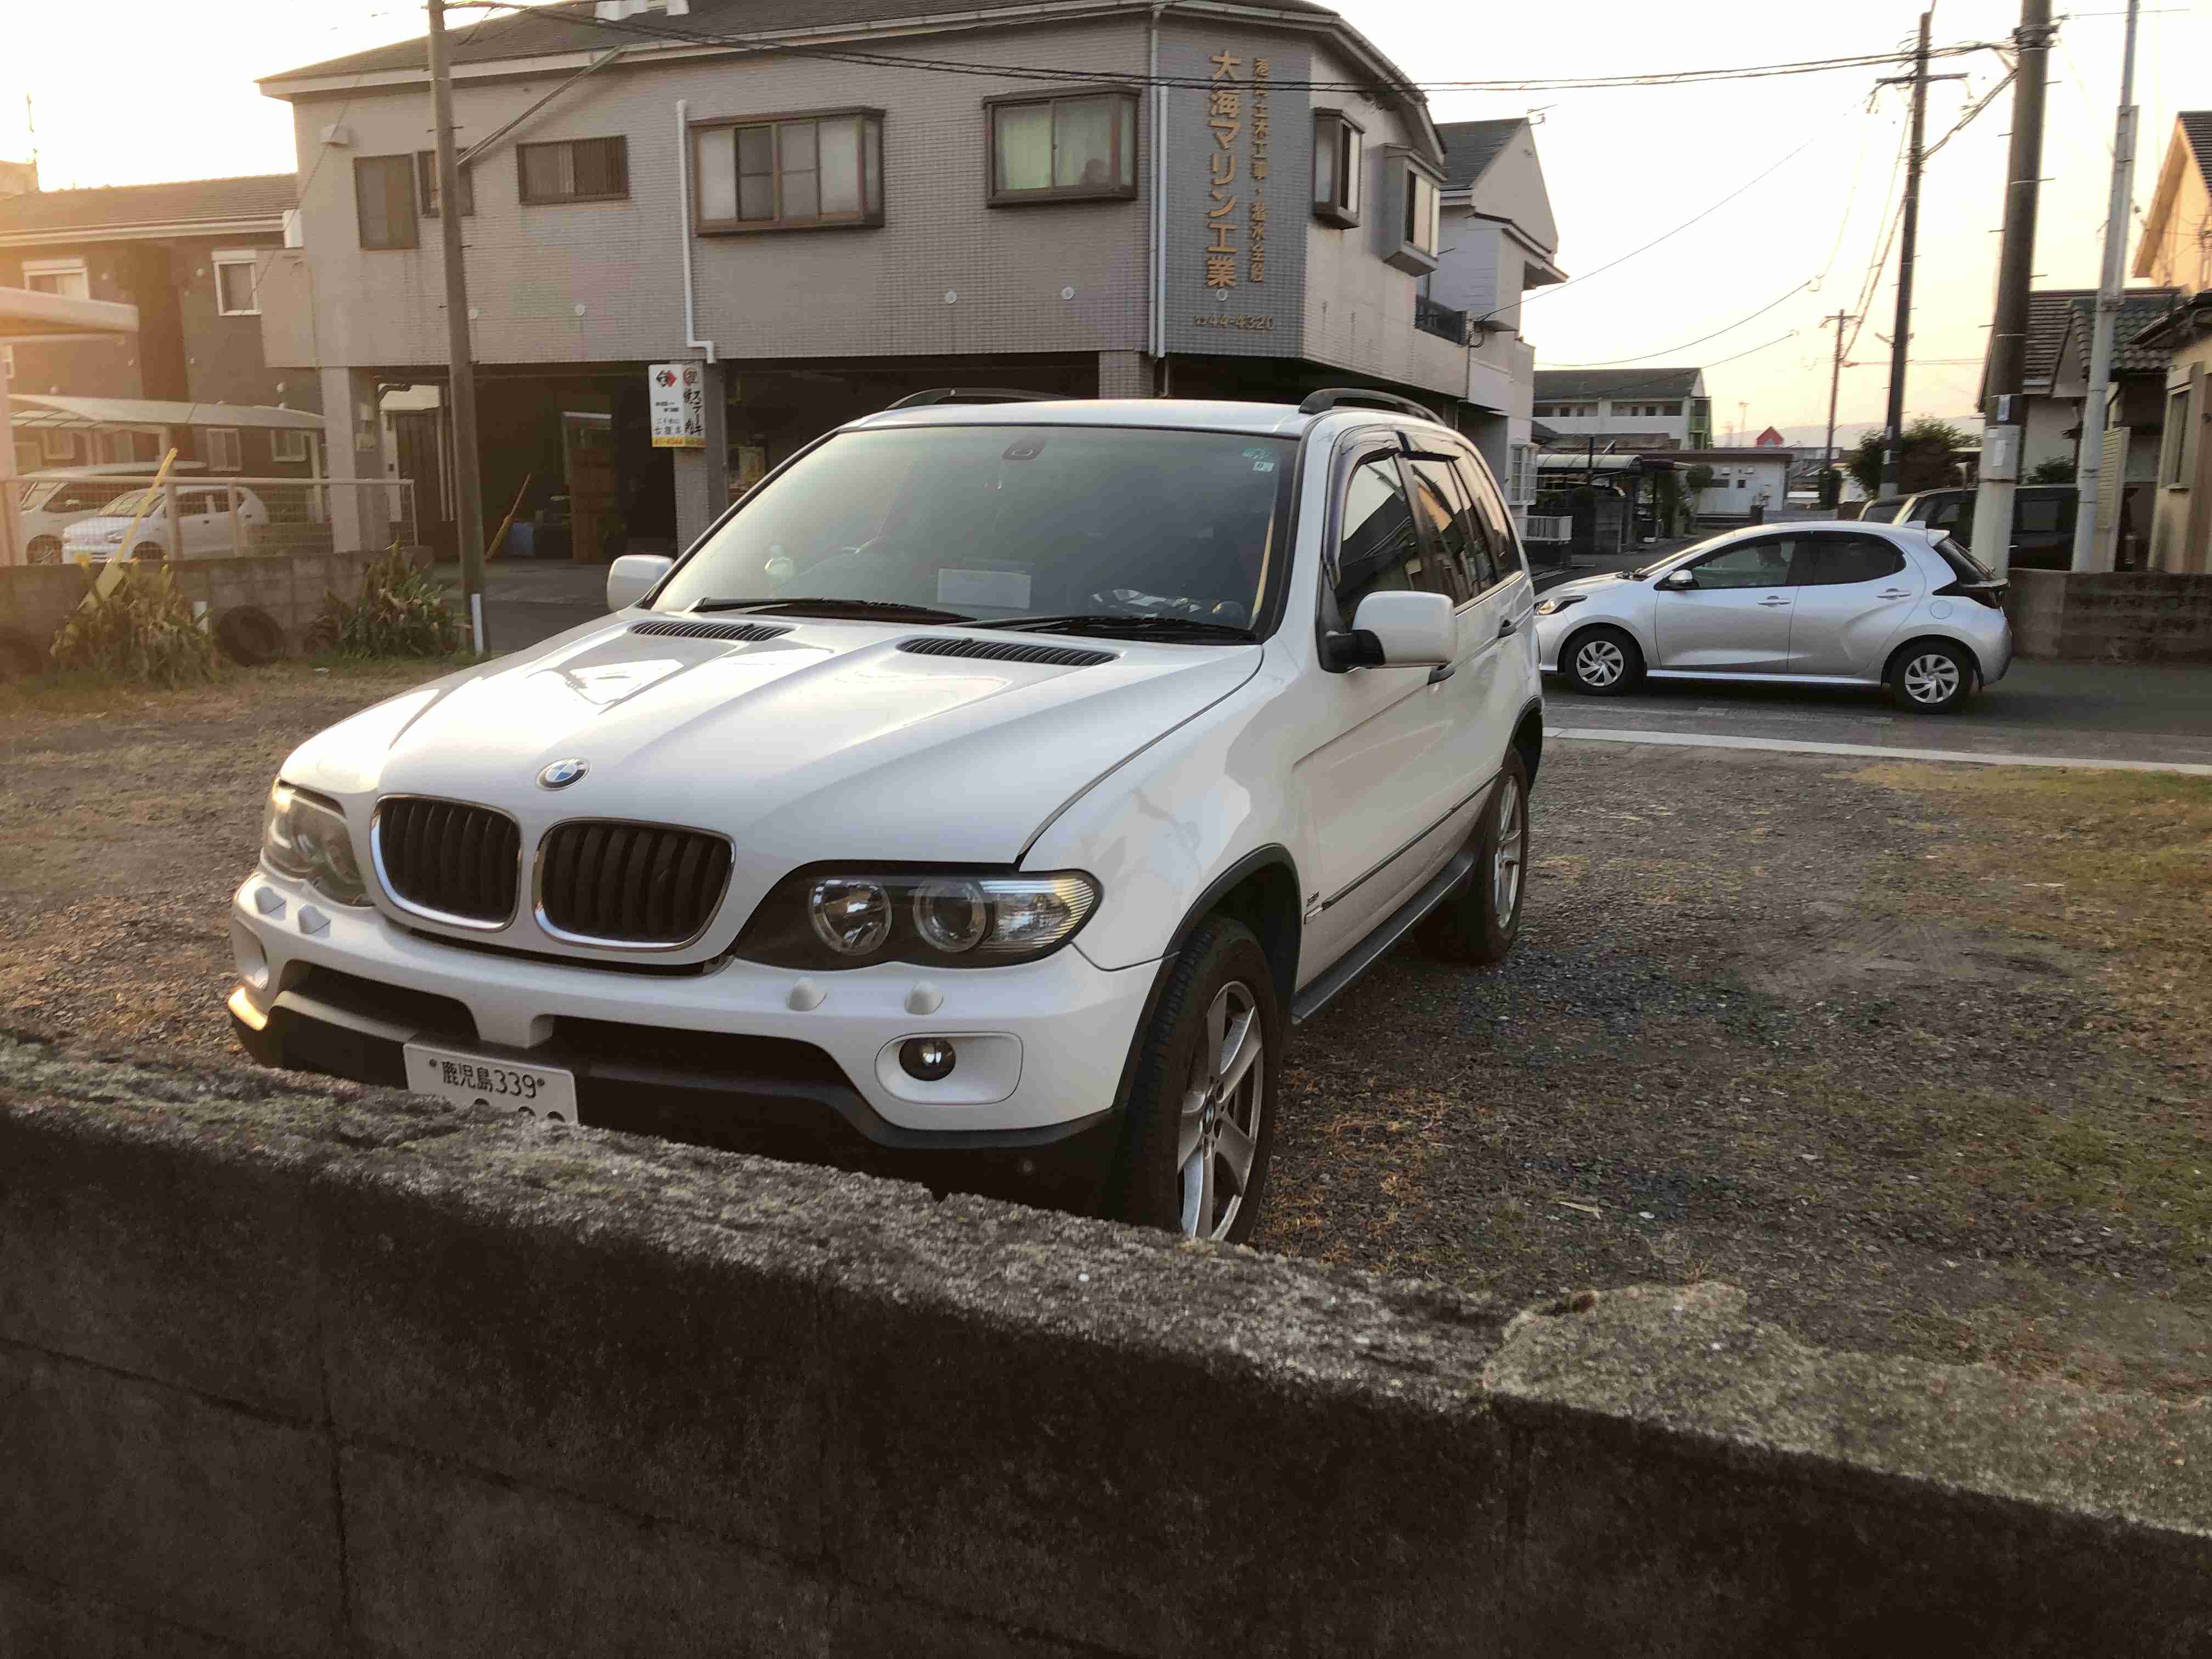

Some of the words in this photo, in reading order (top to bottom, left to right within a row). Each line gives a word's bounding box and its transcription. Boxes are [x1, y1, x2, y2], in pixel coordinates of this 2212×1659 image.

[1207, 50, 1241, 289] 大海マリン工業
